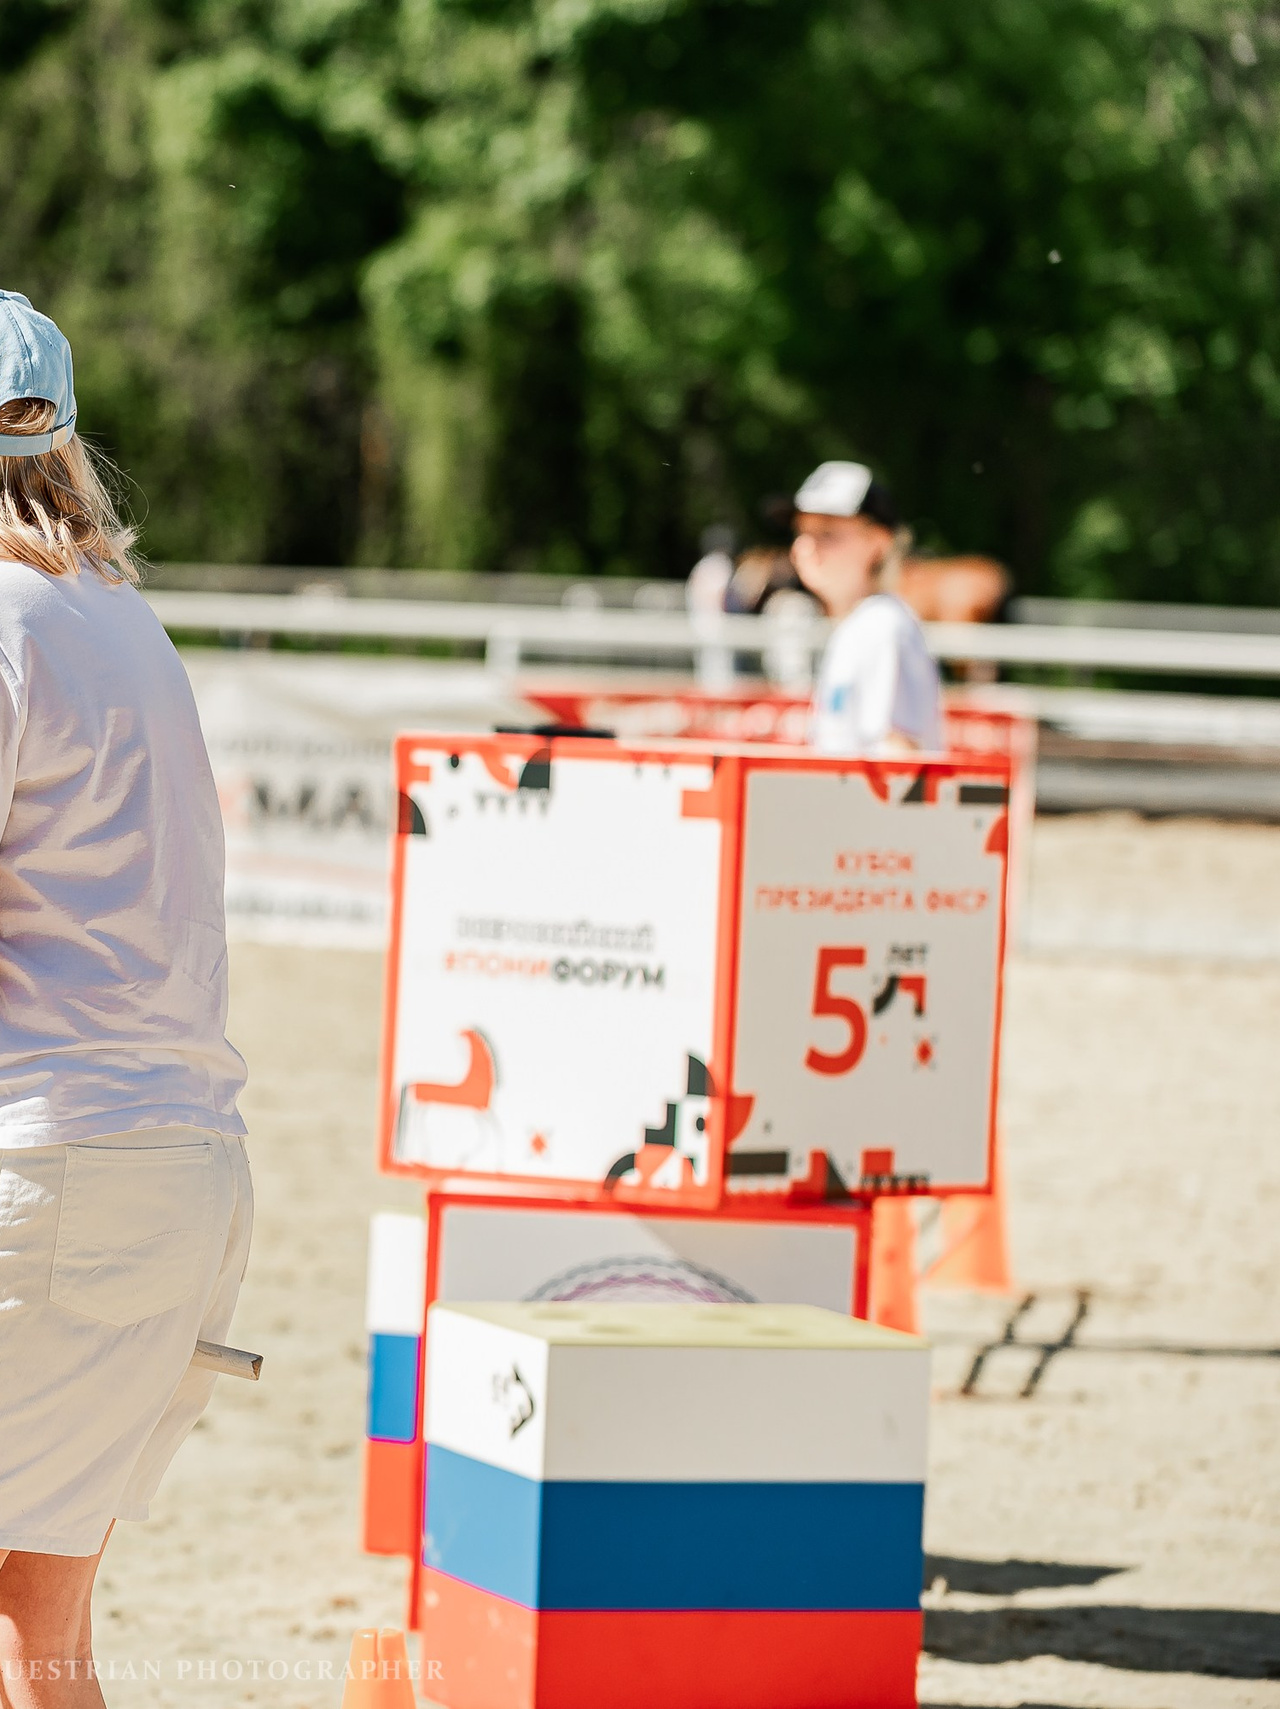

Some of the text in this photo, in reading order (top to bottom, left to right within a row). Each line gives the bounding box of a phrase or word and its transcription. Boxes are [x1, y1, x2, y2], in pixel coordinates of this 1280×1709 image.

[834, 852, 914, 876] КУБОК
[755, 886, 990, 914] ПРЕЗИДЕНТА ФКСР
[804, 943, 928, 1076] 5 ЛЕТ
